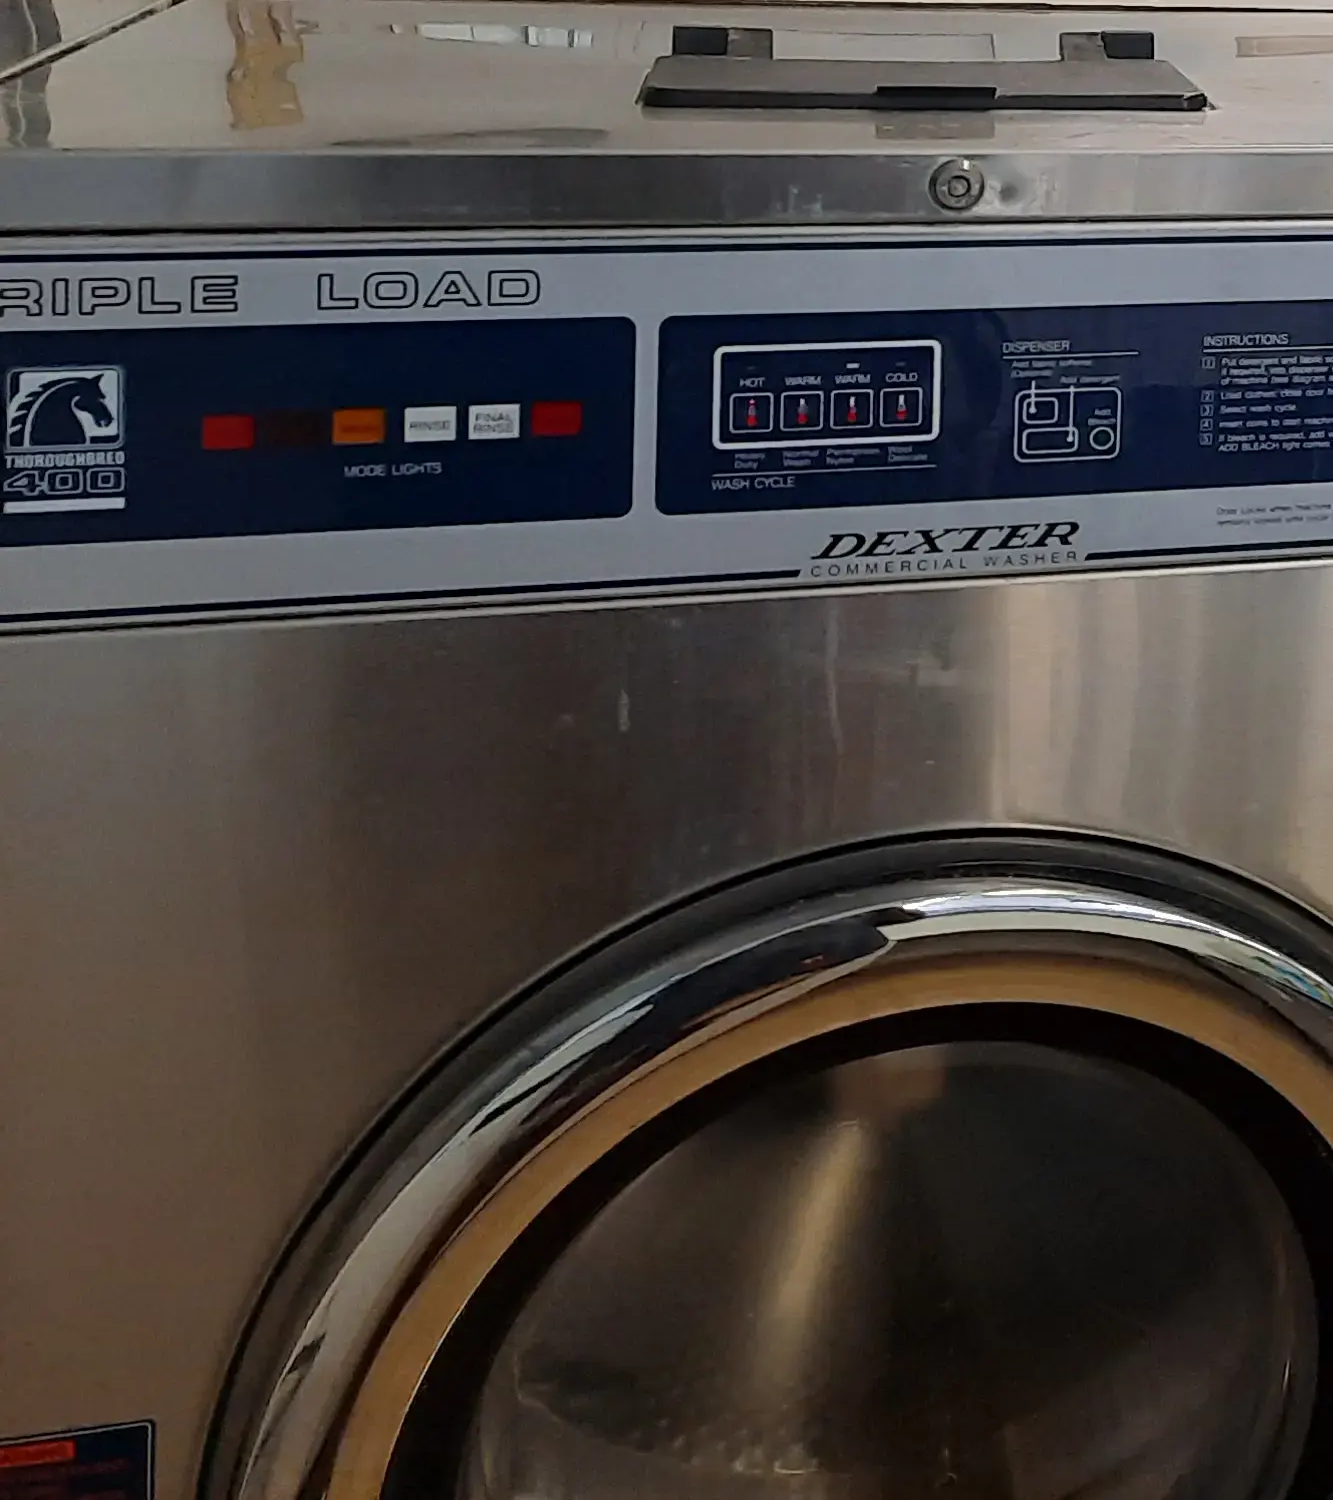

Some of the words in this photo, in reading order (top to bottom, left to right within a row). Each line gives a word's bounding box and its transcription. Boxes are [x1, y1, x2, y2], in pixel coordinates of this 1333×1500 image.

[317, 269, 542, 310] LOAD
[1002, 340, 1070, 353] DISPENSER
[1203, 333, 1289, 347] INSTRUCTIONS
[738, 376, 766, 387] HOT
[885, 372, 918, 383] COLD
[475, 412, 512, 423] FINAL
[409, 420, 451, 432] RINSE
[344, 464, 386, 478] MODE
[391, 463, 443, 476] LIGHTS
[3, 467, 125, 496] 400
[711, 478, 749, 490] WASH
[754, 476, 796, 488] CYCLE
[811, 521, 1080, 560] DEXTER
[811, 557, 968, 578] COMMERCIAL
[984, 551, 1079, 568] WASHER
